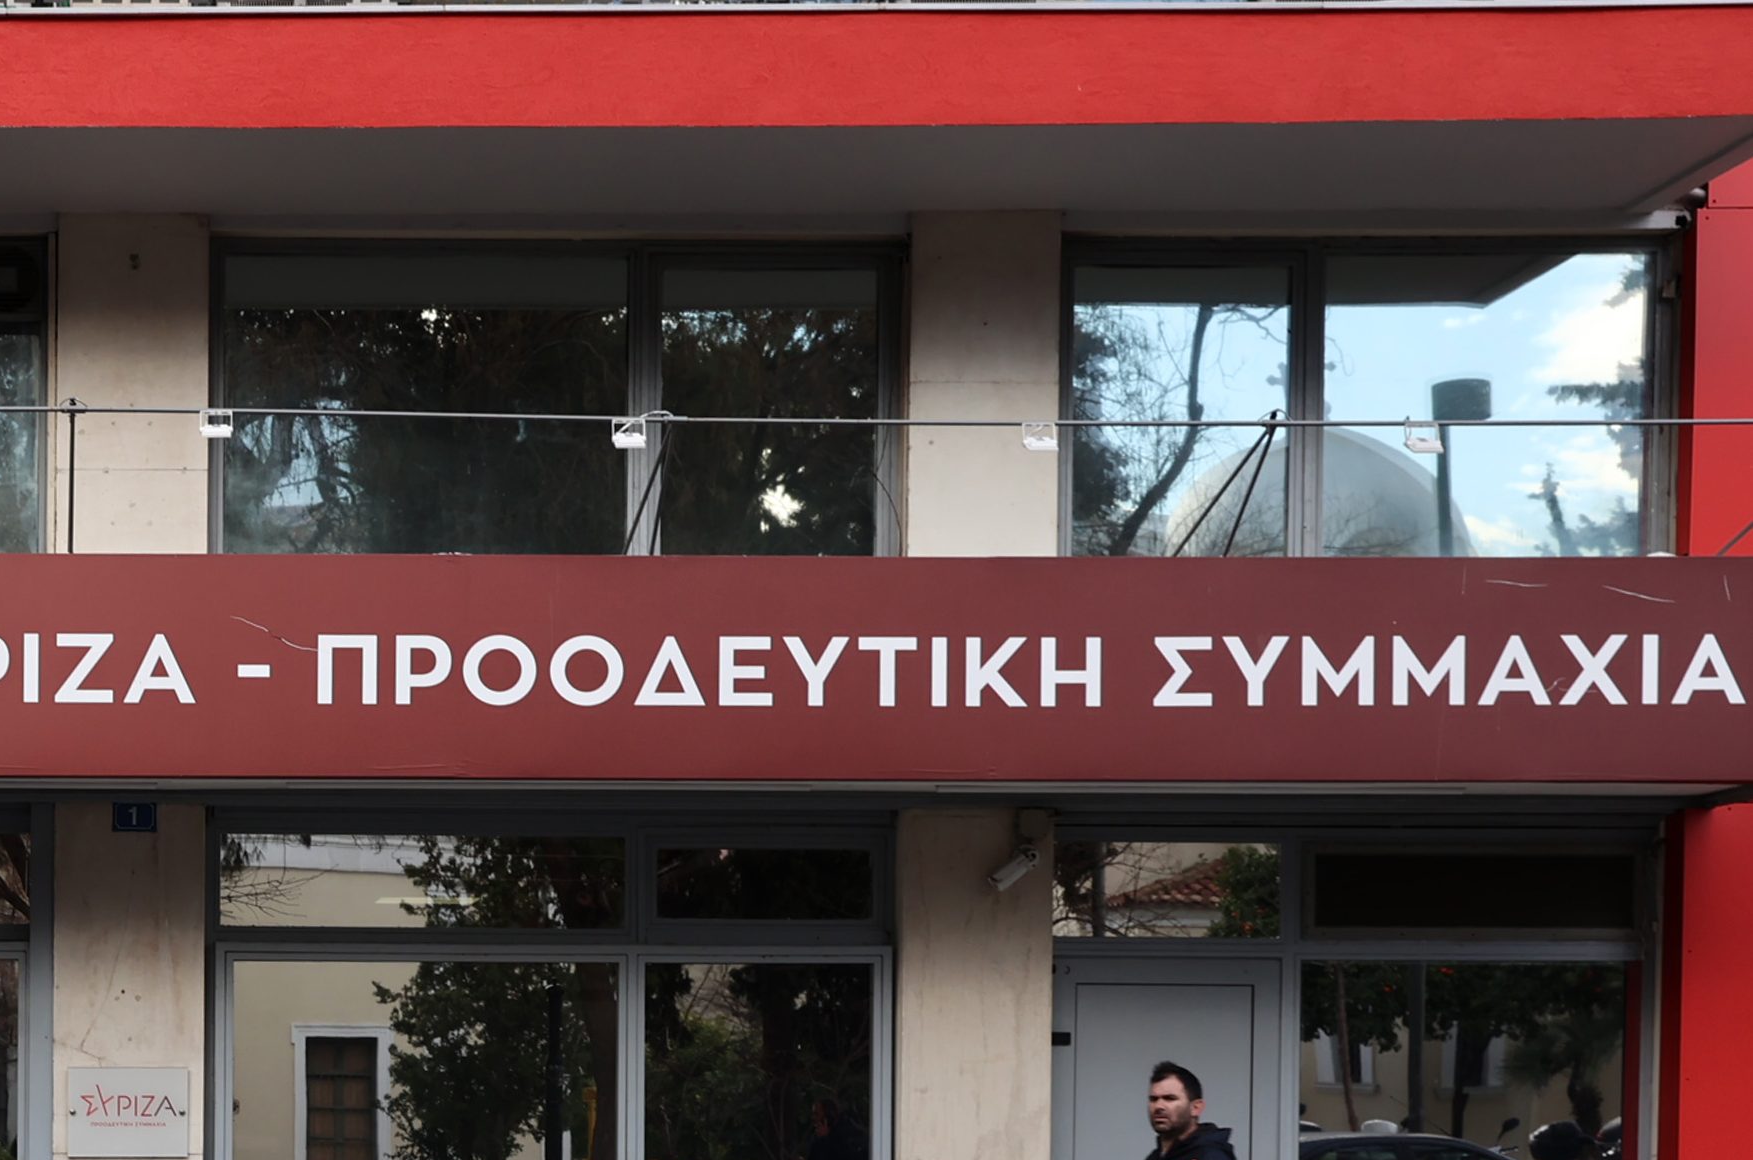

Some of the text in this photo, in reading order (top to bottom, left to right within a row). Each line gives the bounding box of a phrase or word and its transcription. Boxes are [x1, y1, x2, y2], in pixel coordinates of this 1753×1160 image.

[237, 664, 271, 678] -
[315, 634, 1102, 707] ΠΡΟΟΔΕΥΤΙΚΗ
[1153, 633, 1746, 706] ΣΥΜΜΑΧΙΑ
[128, 807, 137, 826] 1
[80, 1084, 177, 1117] ΣΥΡΙΖΑ
